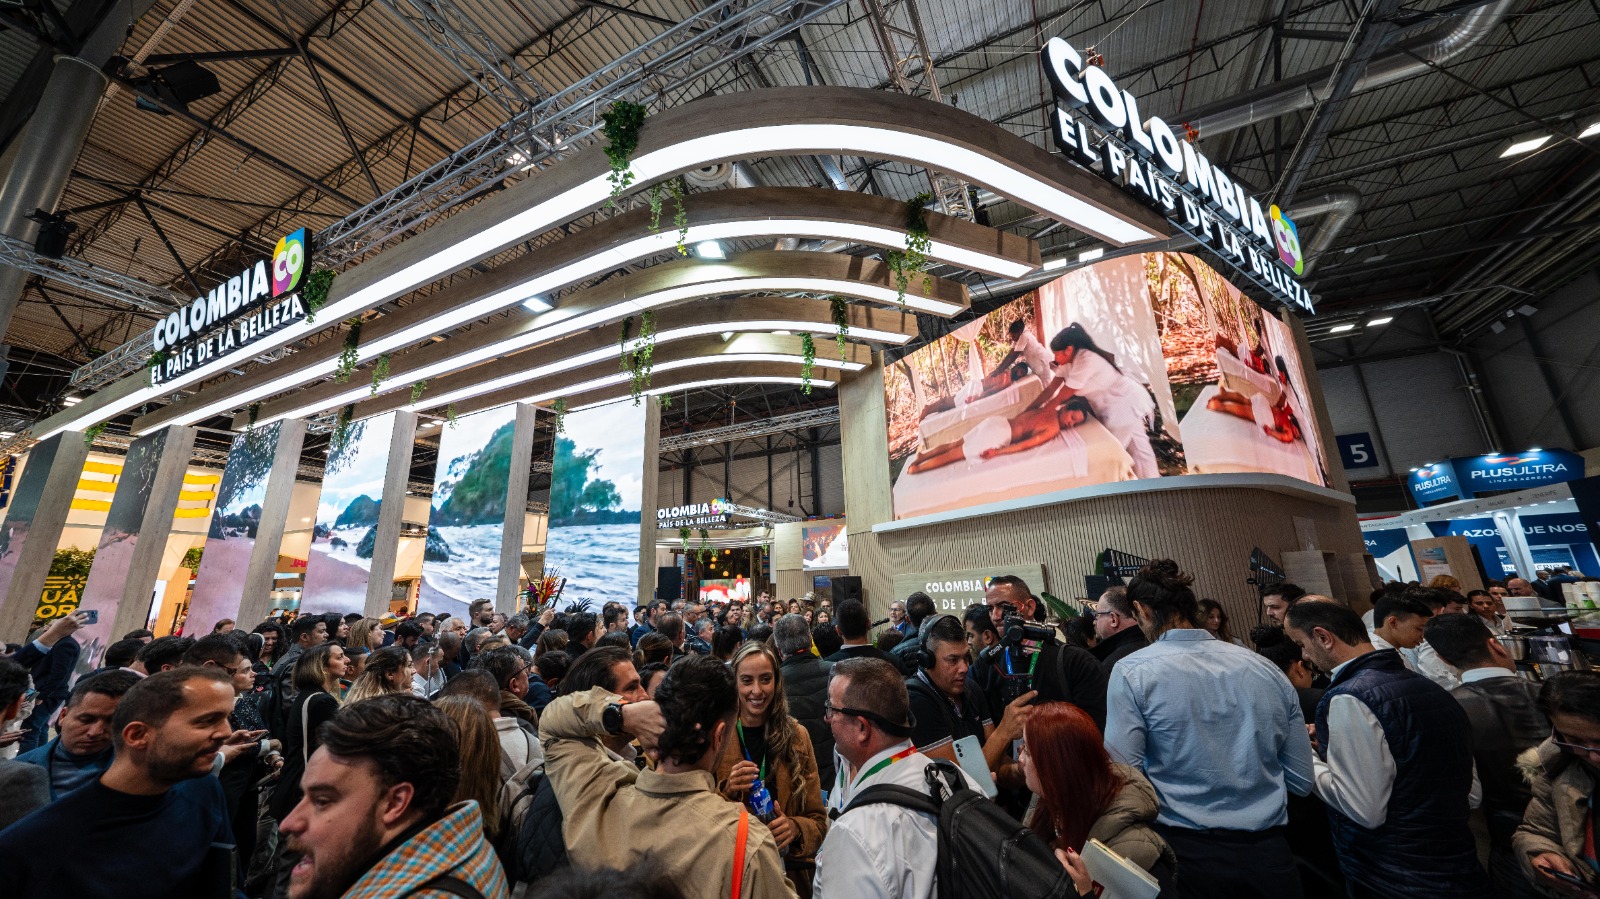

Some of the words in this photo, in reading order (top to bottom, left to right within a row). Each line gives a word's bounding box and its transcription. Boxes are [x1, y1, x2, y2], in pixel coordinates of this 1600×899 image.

[1048, 36, 1274, 249] COLOMBIA
[1057, 107, 1097, 161] EL
[1107, 141, 1174, 210] PAÍS
[1181, 194, 1214, 240] DE
[1217, 221, 1246, 263] LA
[1248, 245, 1316, 316] BELLEZA
[153, 259, 270, 352] COLOMBIA
[151, 363, 163, 384] EL
[166, 345, 193, 378] PAÍS
[197, 337, 214, 363] DE
[218, 327, 235, 354] LA
[240, 293, 304, 343] BELLEZA
[1350, 443, 1369, 463] 5
[1471, 463, 1568, 479] PLUSULTRA
[1414, 475, 1452, 492] PLUSULTRA
[657, 502, 709, 519] OLOMBIA
[696, 515, 726, 524] BELLEZA
[1522, 525, 1547, 535] UE
[1547, 523, 1588, 534] NOS
[925, 579, 983, 594] COLOMBIA
[942, 598, 957, 610] DE
